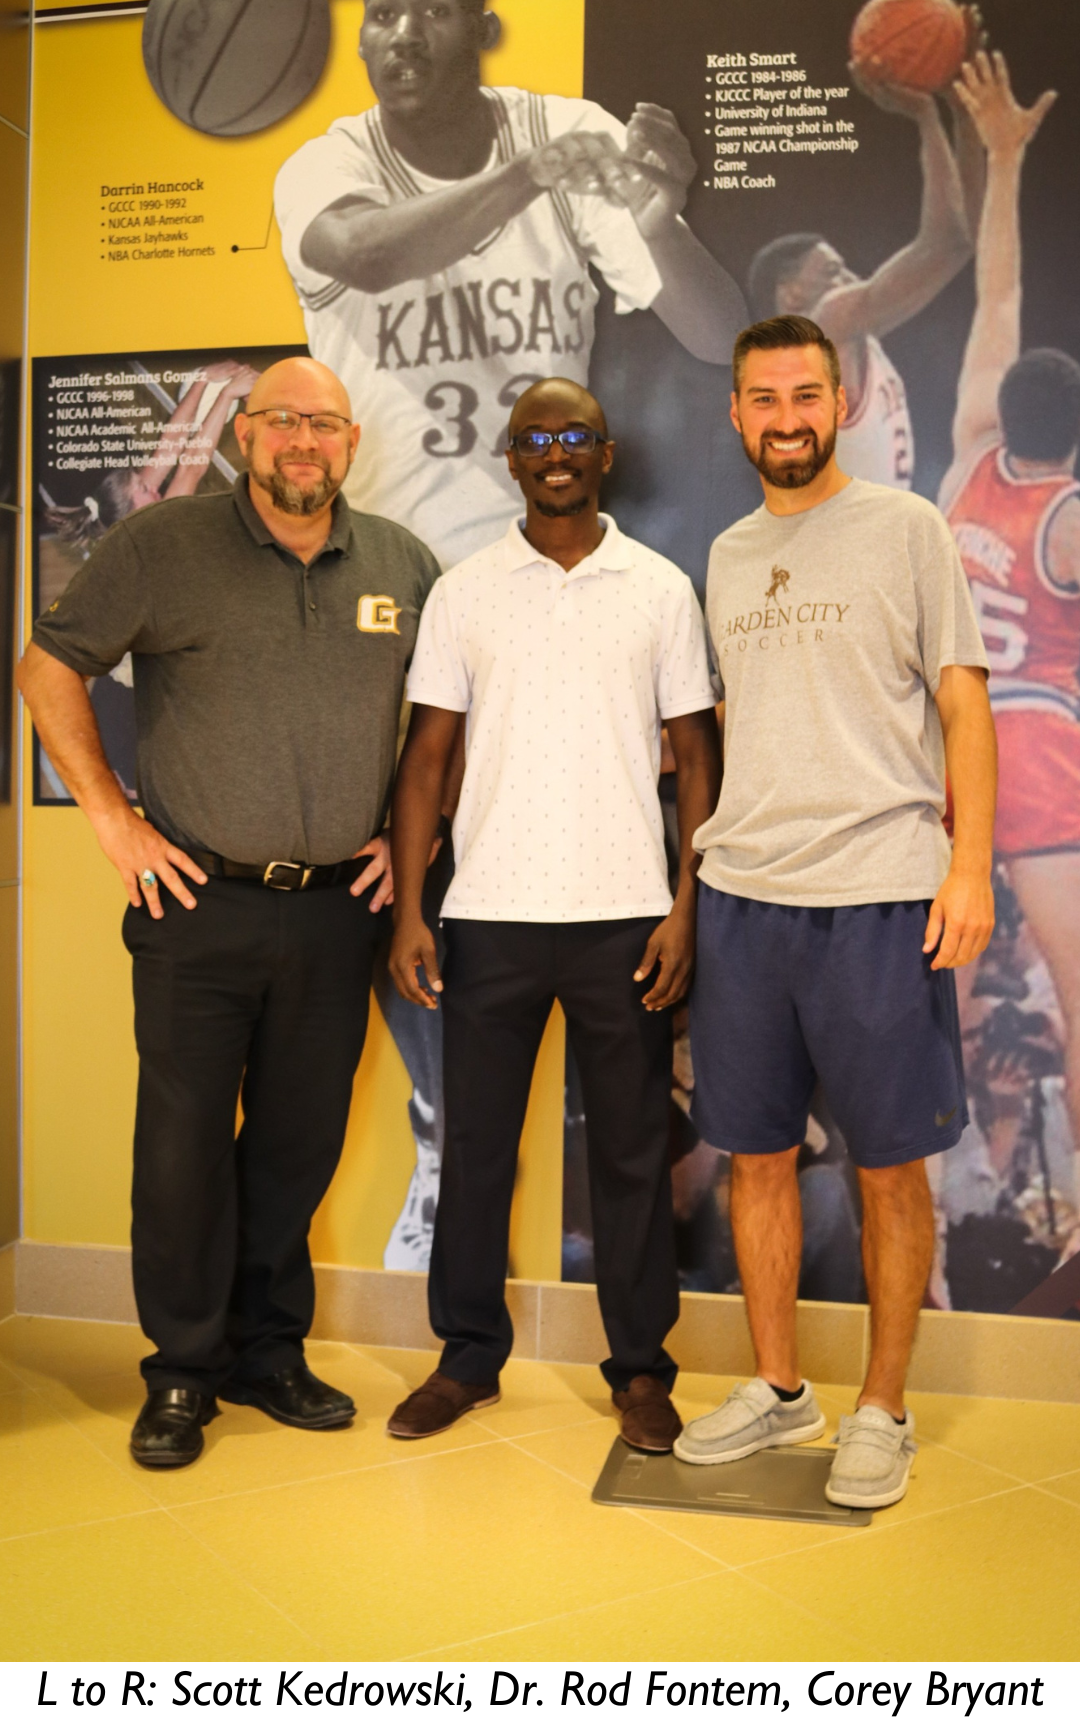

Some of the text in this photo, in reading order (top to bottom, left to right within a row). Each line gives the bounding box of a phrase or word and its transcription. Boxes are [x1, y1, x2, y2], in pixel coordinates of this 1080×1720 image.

[706, 52, 797, 68] Keith Smart
[715, 70, 807, 85] GCCC 1984-1986
[715, 85, 849, 103] KJCCC Player of the year
[715, 103, 827, 121] University of Indiana
[714, 119, 855, 138] Game winning shot in the
[716, 137, 859, 155] 1987 NCAA Championship
[714, 159, 747, 172] Game
[100, 178, 204, 197] Darrin Hancock
[714, 174, 776, 190] NBA Coach
[108, 198, 187, 213] GCCC 1990-1992
[108, 214, 204, 229] NJCAA All-American
[108, 230, 188, 245] Kansas Jayhawks
[108, 246, 216, 261] NBA Charlotte Hornets
[376, 278, 585, 371] KANSAS
[48, 370, 208, 389] Jennifer Salmans Gomez
[56, 390, 134, 404] GCCC 1996-1998
[56, 405, 152, 420] NJCAA All-American
[56, 420, 203, 437] NJCAA Academic All-American
[56, 441, 99, 454] Colorado
[101, 439, 125, 452] State
[56, 454, 210, 472] Collegiate Head Volleyball Coach
[722, 603, 850, 640] ARDEN CITY
[723, 628, 824, 657] SOCCER
